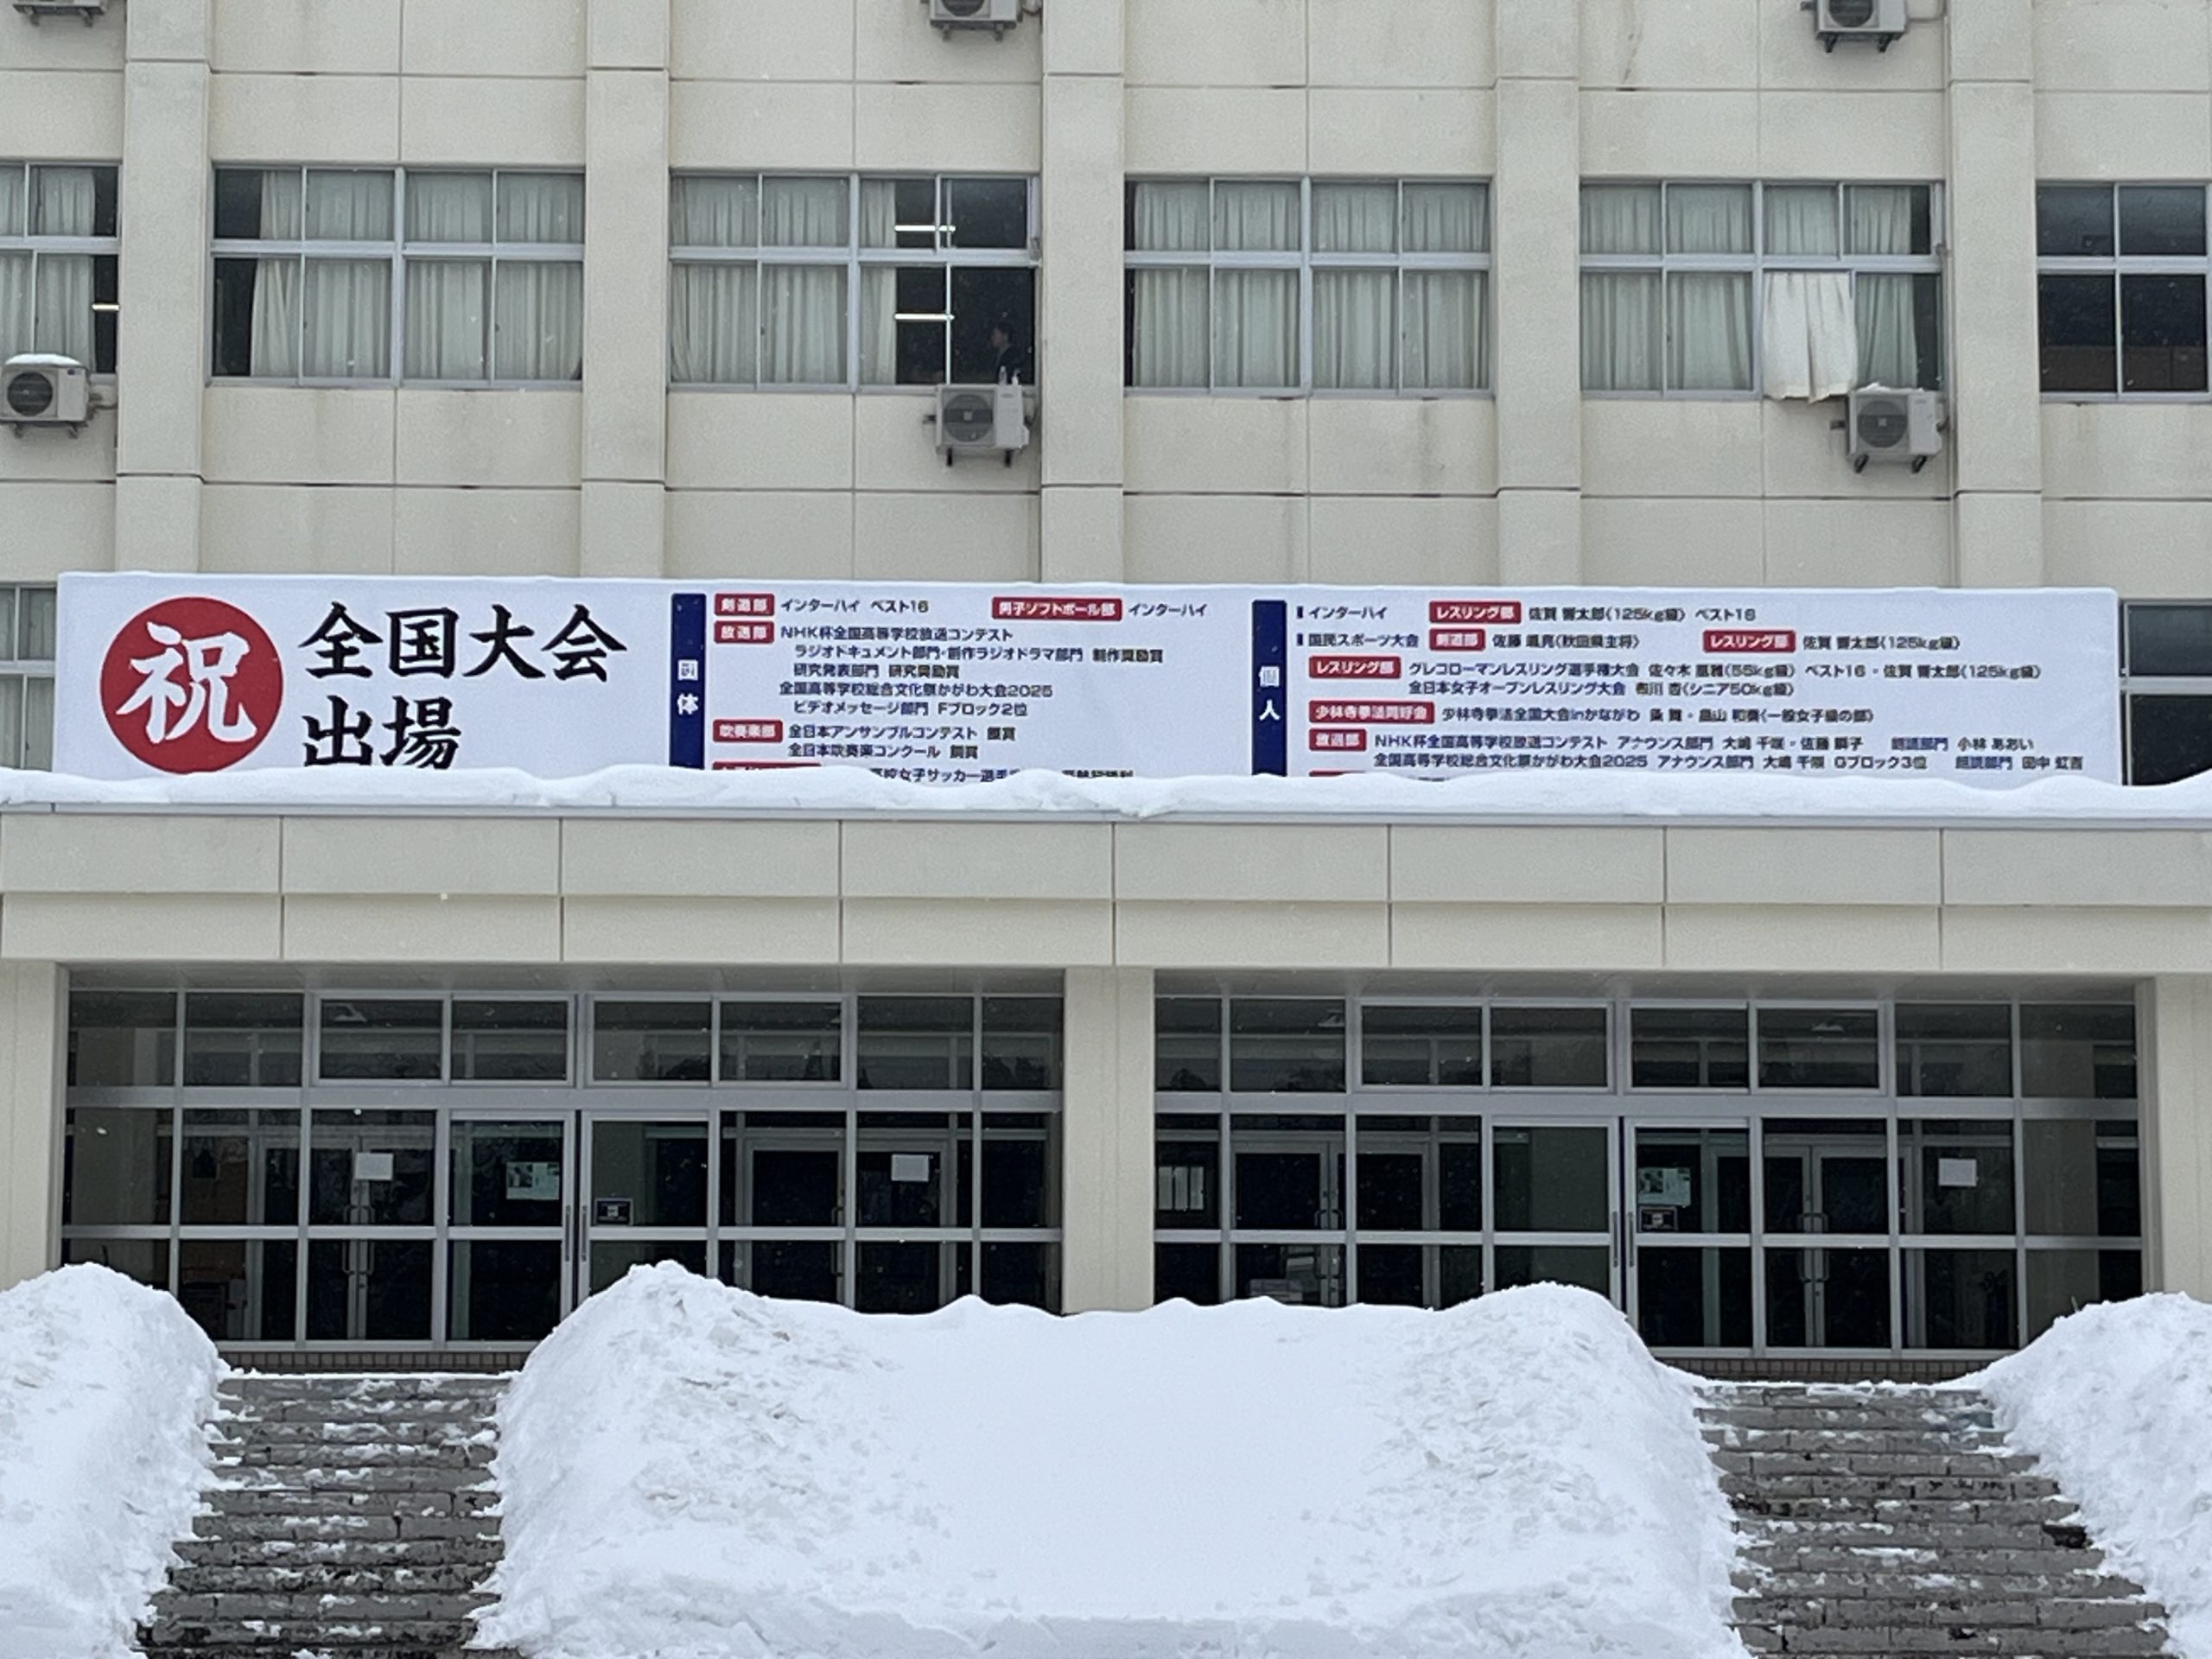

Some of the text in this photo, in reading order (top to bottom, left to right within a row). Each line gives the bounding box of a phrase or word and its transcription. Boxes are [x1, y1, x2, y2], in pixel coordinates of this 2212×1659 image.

[781, 599, 929, 613] インターハイ ベスト16
[1128, 603, 1208, 617] インターハイ
[1308, 606, 1388, 620] インターハイ
[1436, 604, 1514, 619] レスリング部
[1694, 608, 1757, 621] ベスト16
[298, 600, 628, 683] 全国大会
[1308, 633, 1419, 648] 国民スポーツ大会
[1710, 633, 1789, 648] レスリング部
[1316, 660, 1395, 675] レスリング部
[1648, 664, 1691, 677] 佐々木
[116, 620, 257, 745] 祝
[677, 659, 699, 715] 団体
[1408, 681, 1625, 696] 全日本女子オープンレスリング大会
[794, 701, 1028, 717] ビデオメッセージ部門 Fブロック2位
[302, 694, 462, 769] 出場
[788, 724, 977, 741] 全日本アンサンブルコンテスト
[788, 743, 940, 759] 全日本吹奏楽コンクール
[1617, 736, 1714, 751] アナウンス部門
[1957, 737, 1987, 752] 小林
[1657, 755, 1754, 769] アナウンス部門
[2021, 756, 2050, 771] 田中
